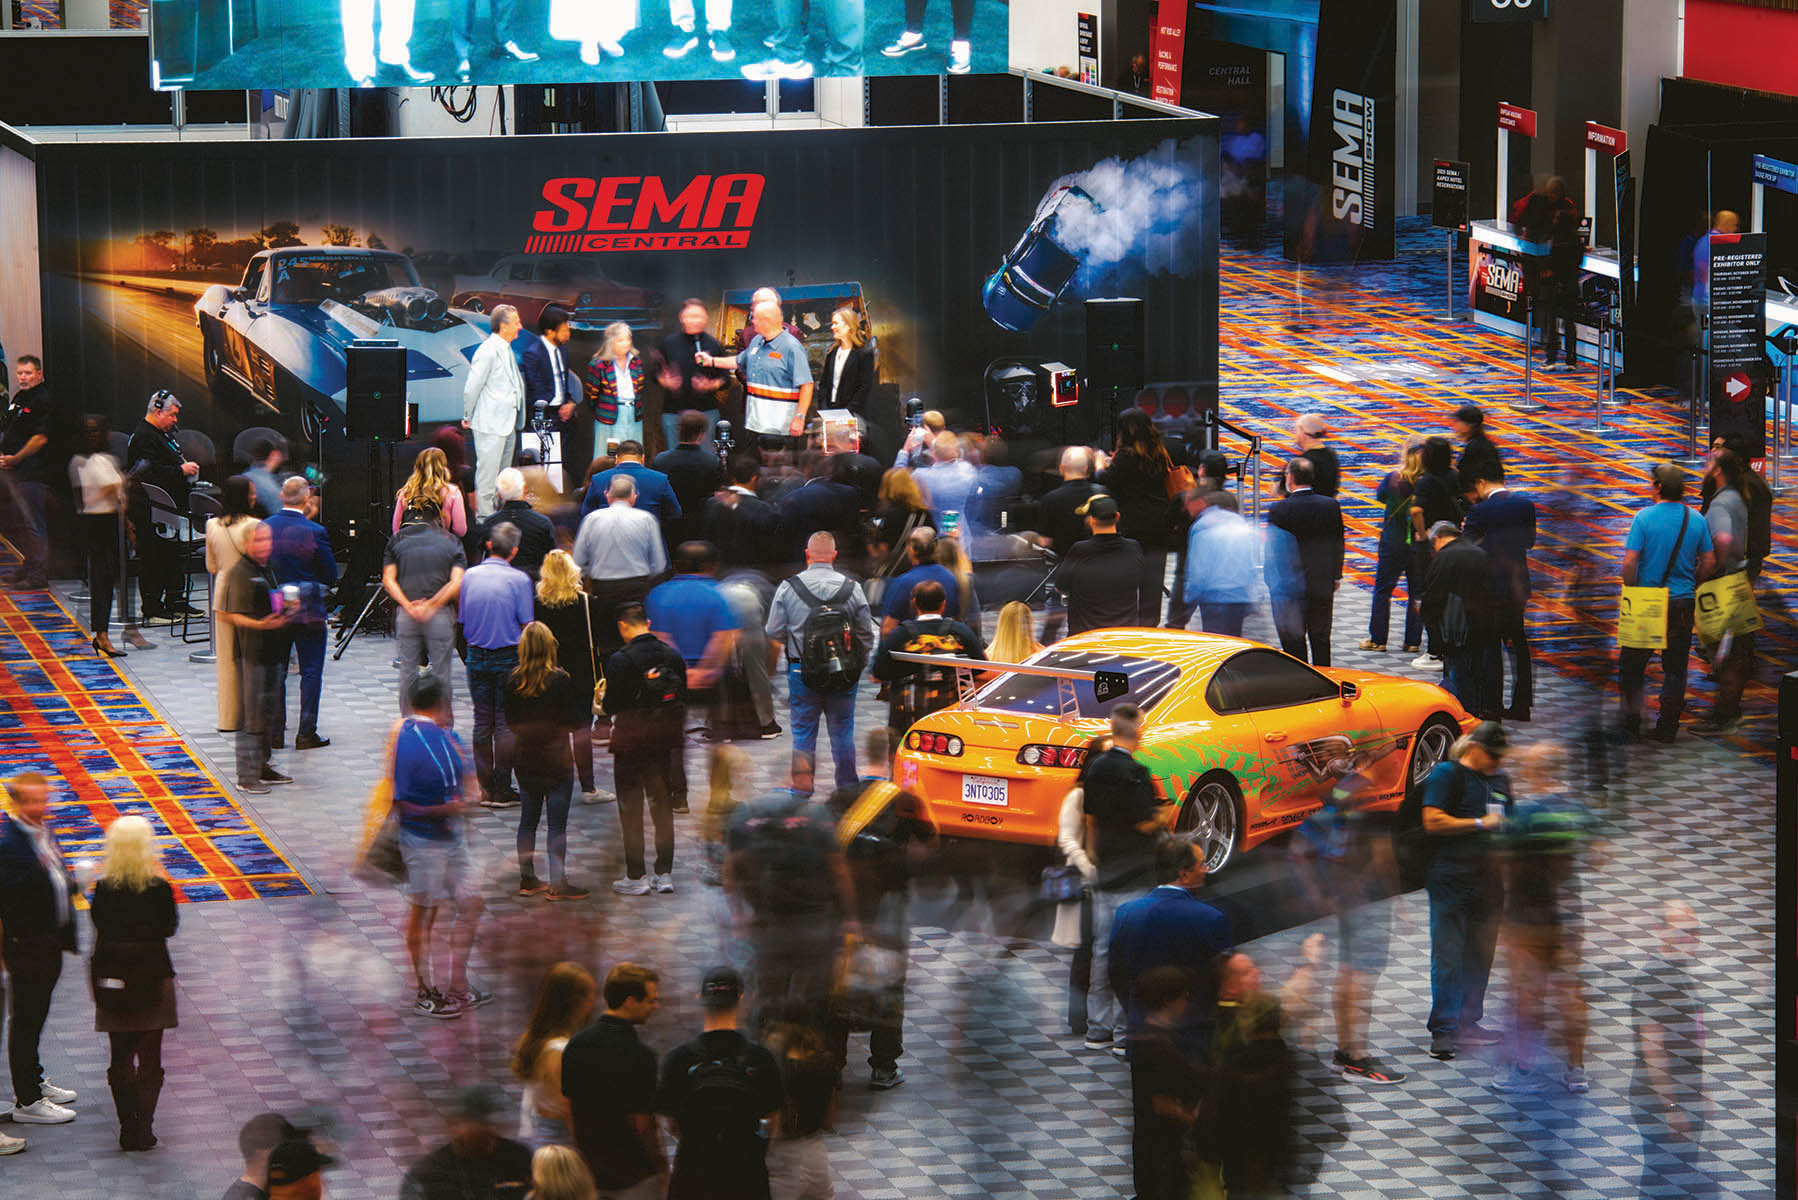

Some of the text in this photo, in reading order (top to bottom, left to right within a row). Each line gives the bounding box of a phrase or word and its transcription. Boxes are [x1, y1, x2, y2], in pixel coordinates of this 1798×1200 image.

[1209, 66, 1251, 76] CENTRAL
[1228, 76, 1250, 85] HALL
[1588, 131, 1616, 146] INFORMATION
[1333, 88, 1363, 225] SEMA
[532, 173, 765, 232] SEMA
[587, 235, 742, 249] CENTRAL
[1487, 264, 1520, 294] SEMA
